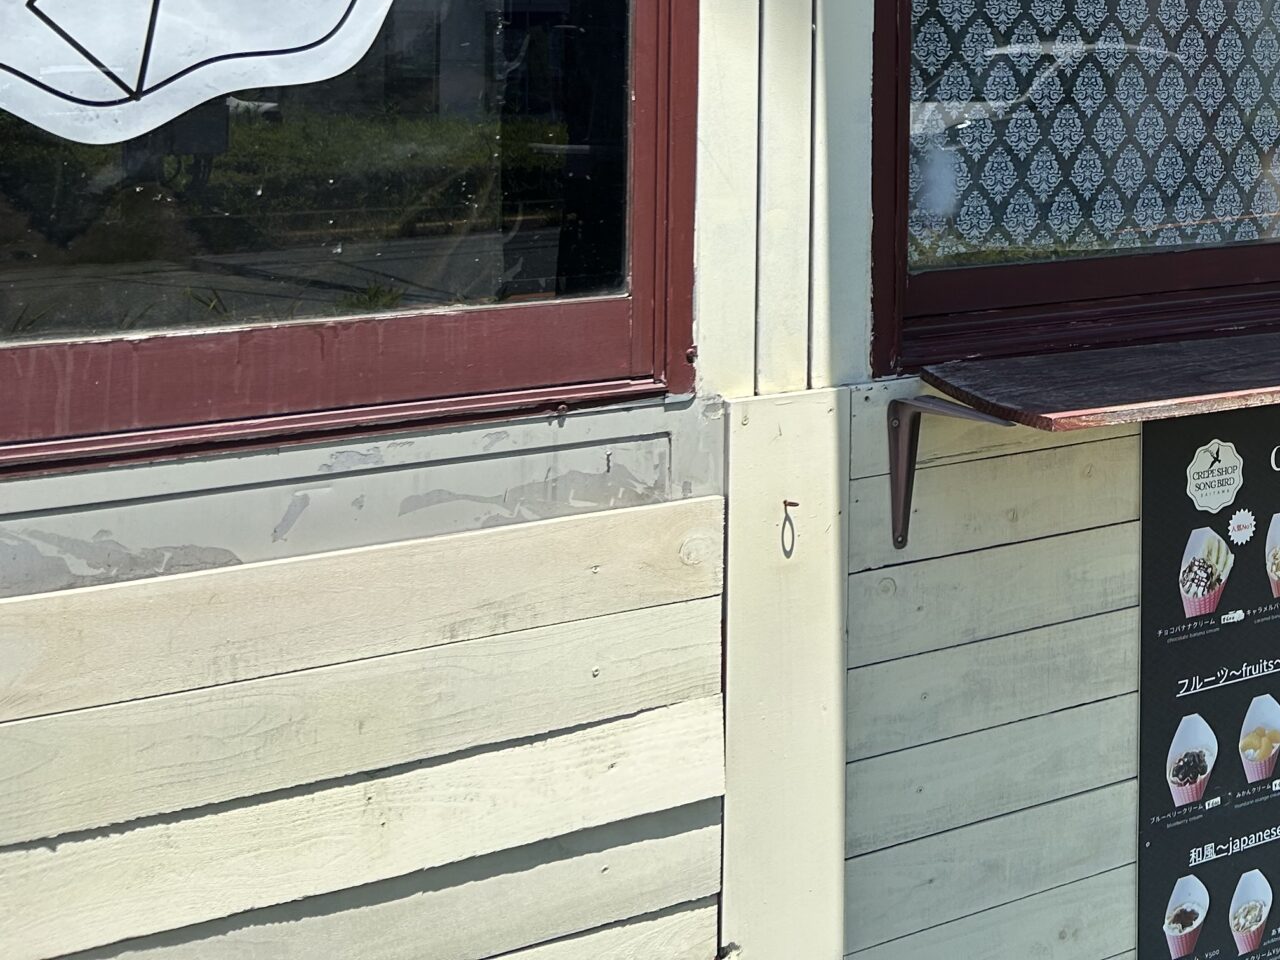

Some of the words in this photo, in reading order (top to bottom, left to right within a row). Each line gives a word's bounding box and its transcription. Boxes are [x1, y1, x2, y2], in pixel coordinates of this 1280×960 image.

[1193, 469, 1217, 481] CREPE
[1216, 465, 1238, 477] SHOP
[1195, 480, 1217, 491] SONG
[1217, 477, 1235, 487] BIRD
[1156, 618, 1216, 638] チョコバナナクリーム
[1236, 784, 1272, 798] みかんクリーム
[1205, 949, 1220, 958] ¥500
